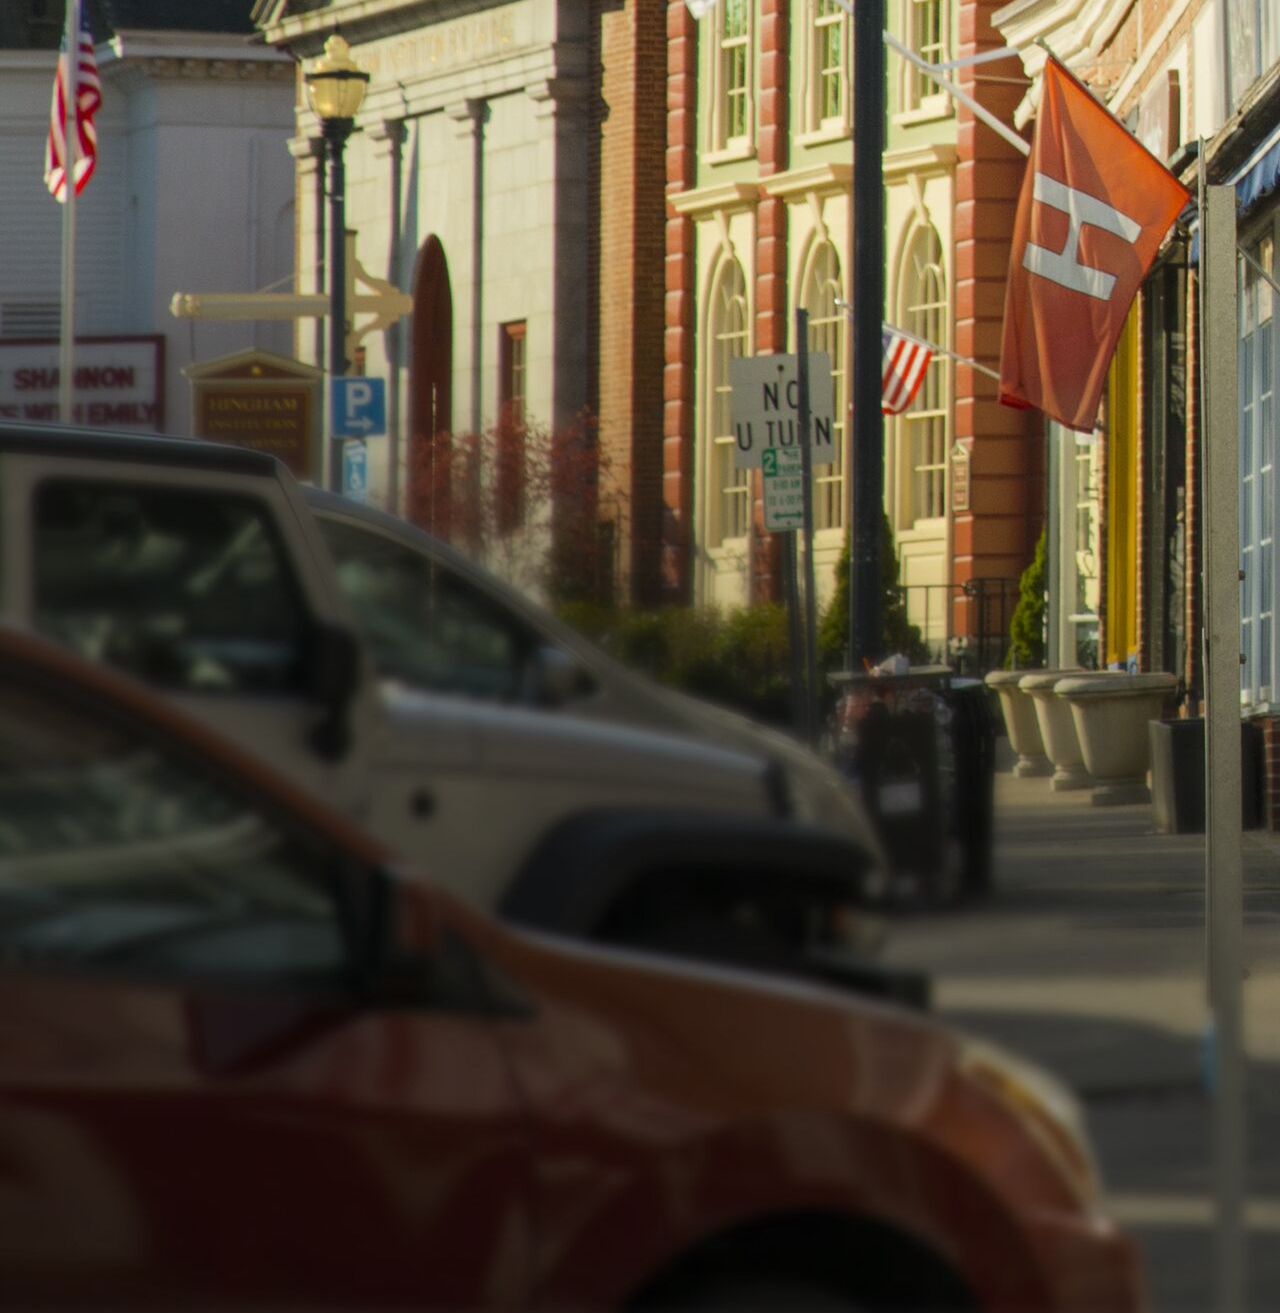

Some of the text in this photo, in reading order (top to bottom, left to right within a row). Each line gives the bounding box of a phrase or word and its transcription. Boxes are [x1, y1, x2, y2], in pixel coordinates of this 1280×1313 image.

[1022, 172, 1143, 301] H
[346, 382, 371, 417] P
[736, 417, 831, 452] U TUN
[764, 451, 776, 474] 2
